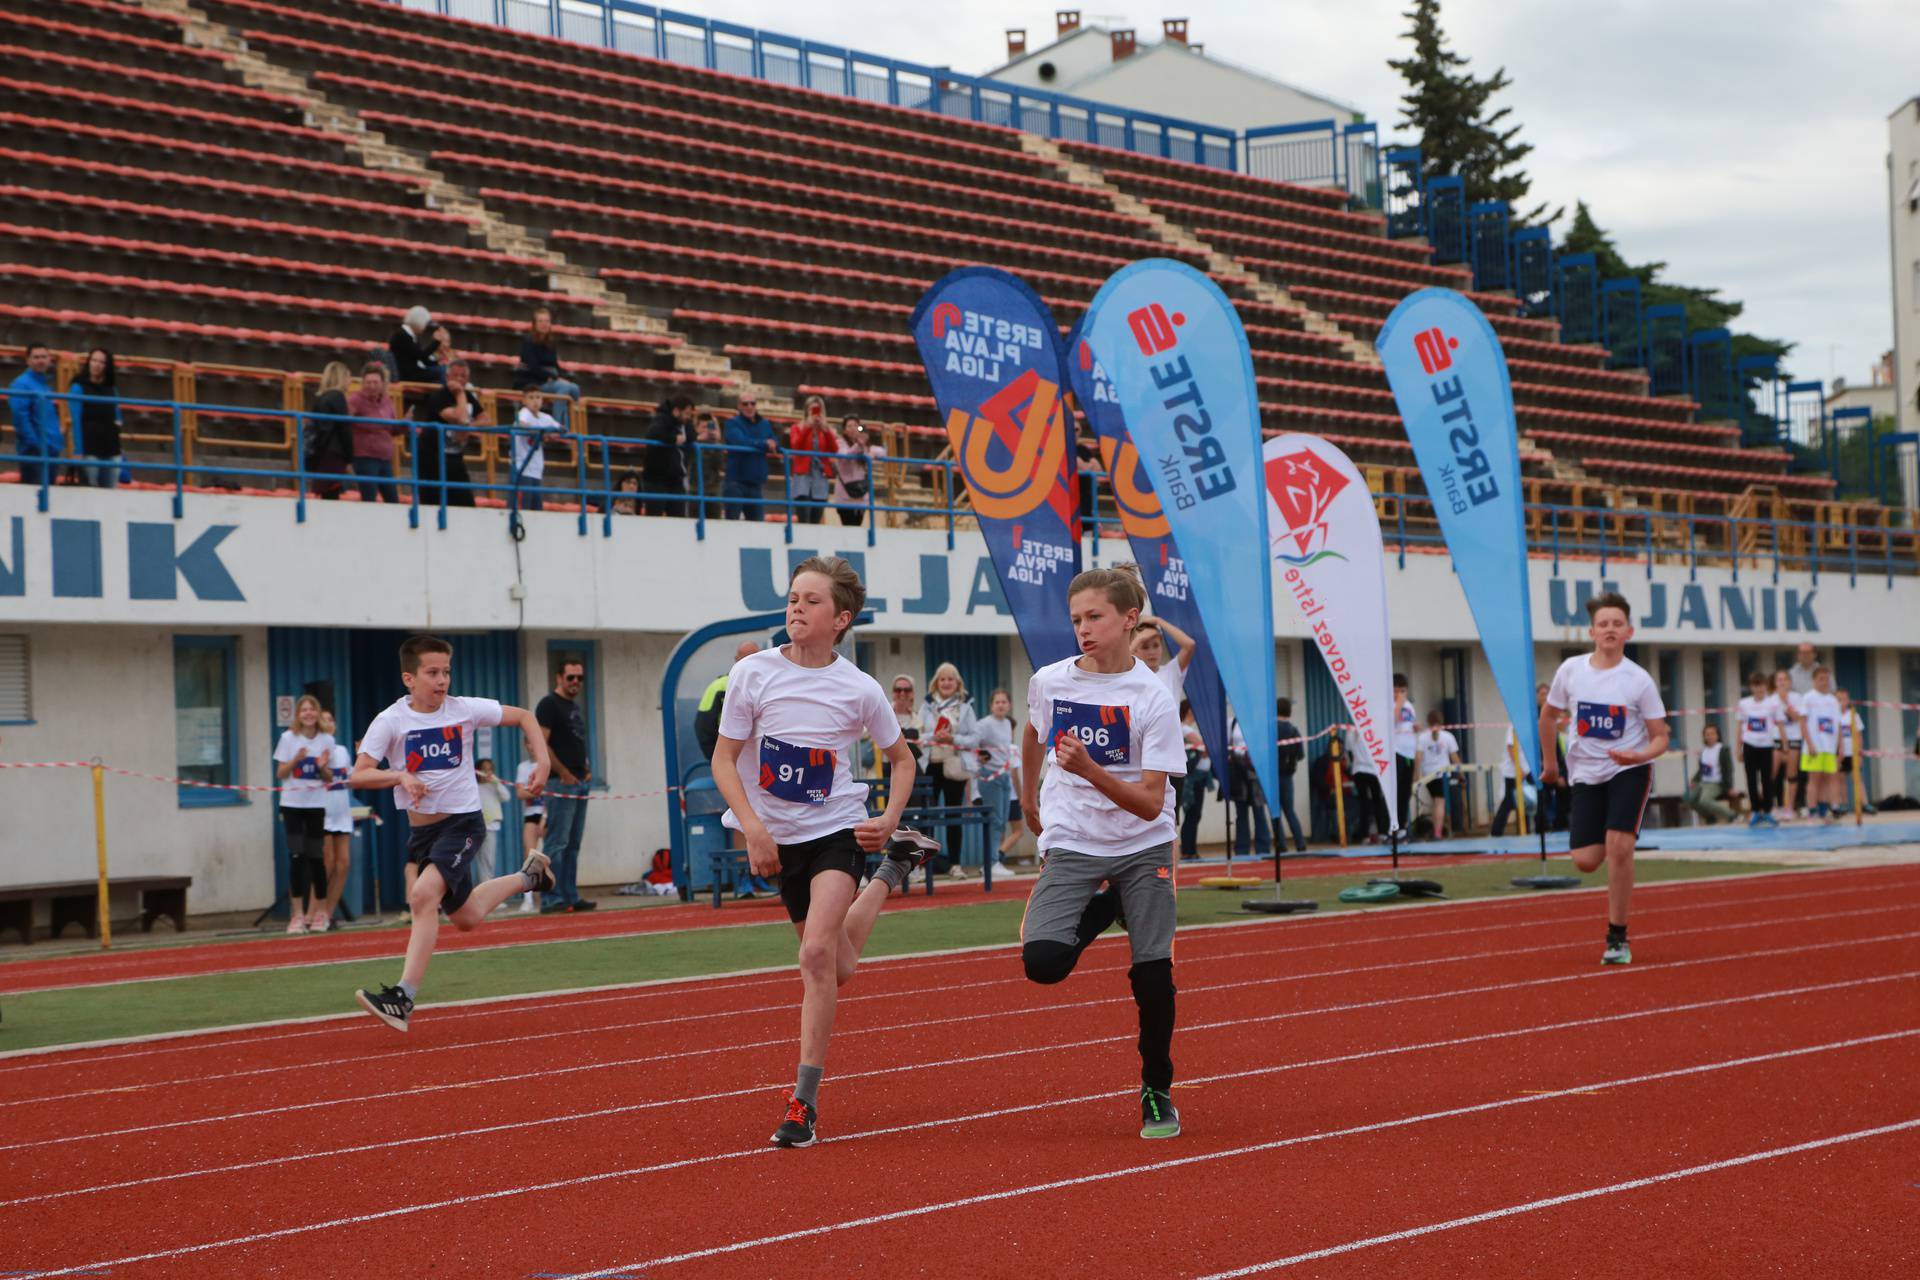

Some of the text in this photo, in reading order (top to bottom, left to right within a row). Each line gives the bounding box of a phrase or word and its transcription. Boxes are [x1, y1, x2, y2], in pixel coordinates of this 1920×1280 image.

[0, 515, 248, 602] IK
[1069, 725, 1110, 747] 196
[420, 742, 452, 759] 104
[778, 764, 805, 785] 91
